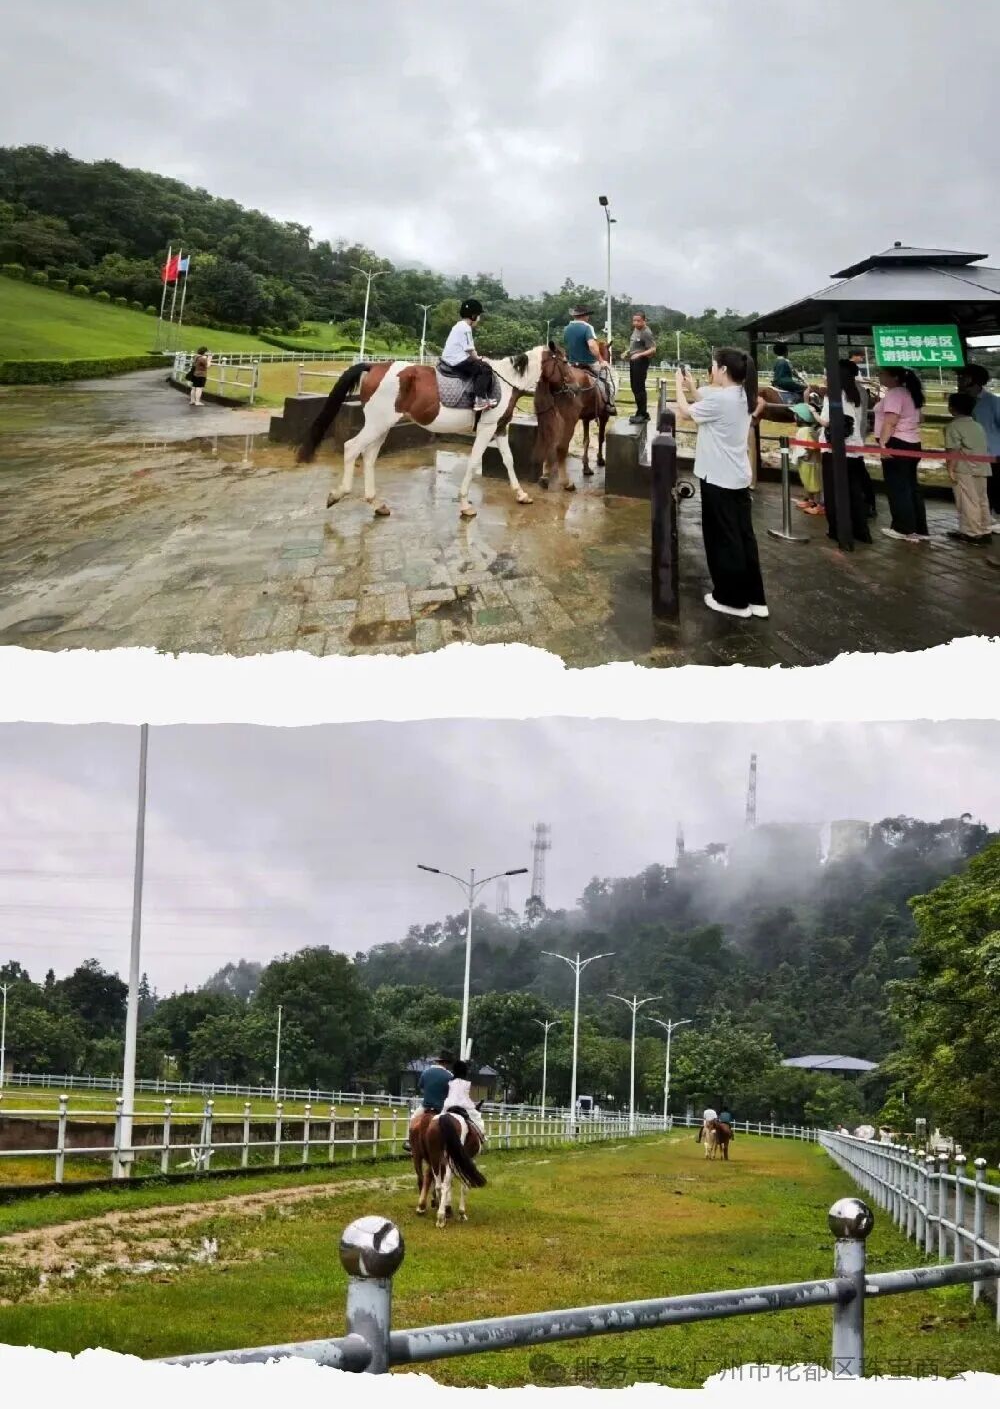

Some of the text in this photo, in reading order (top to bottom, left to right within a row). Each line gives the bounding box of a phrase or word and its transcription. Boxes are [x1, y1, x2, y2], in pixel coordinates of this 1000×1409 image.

[879, 335, 955, 348] 骑马等候区
